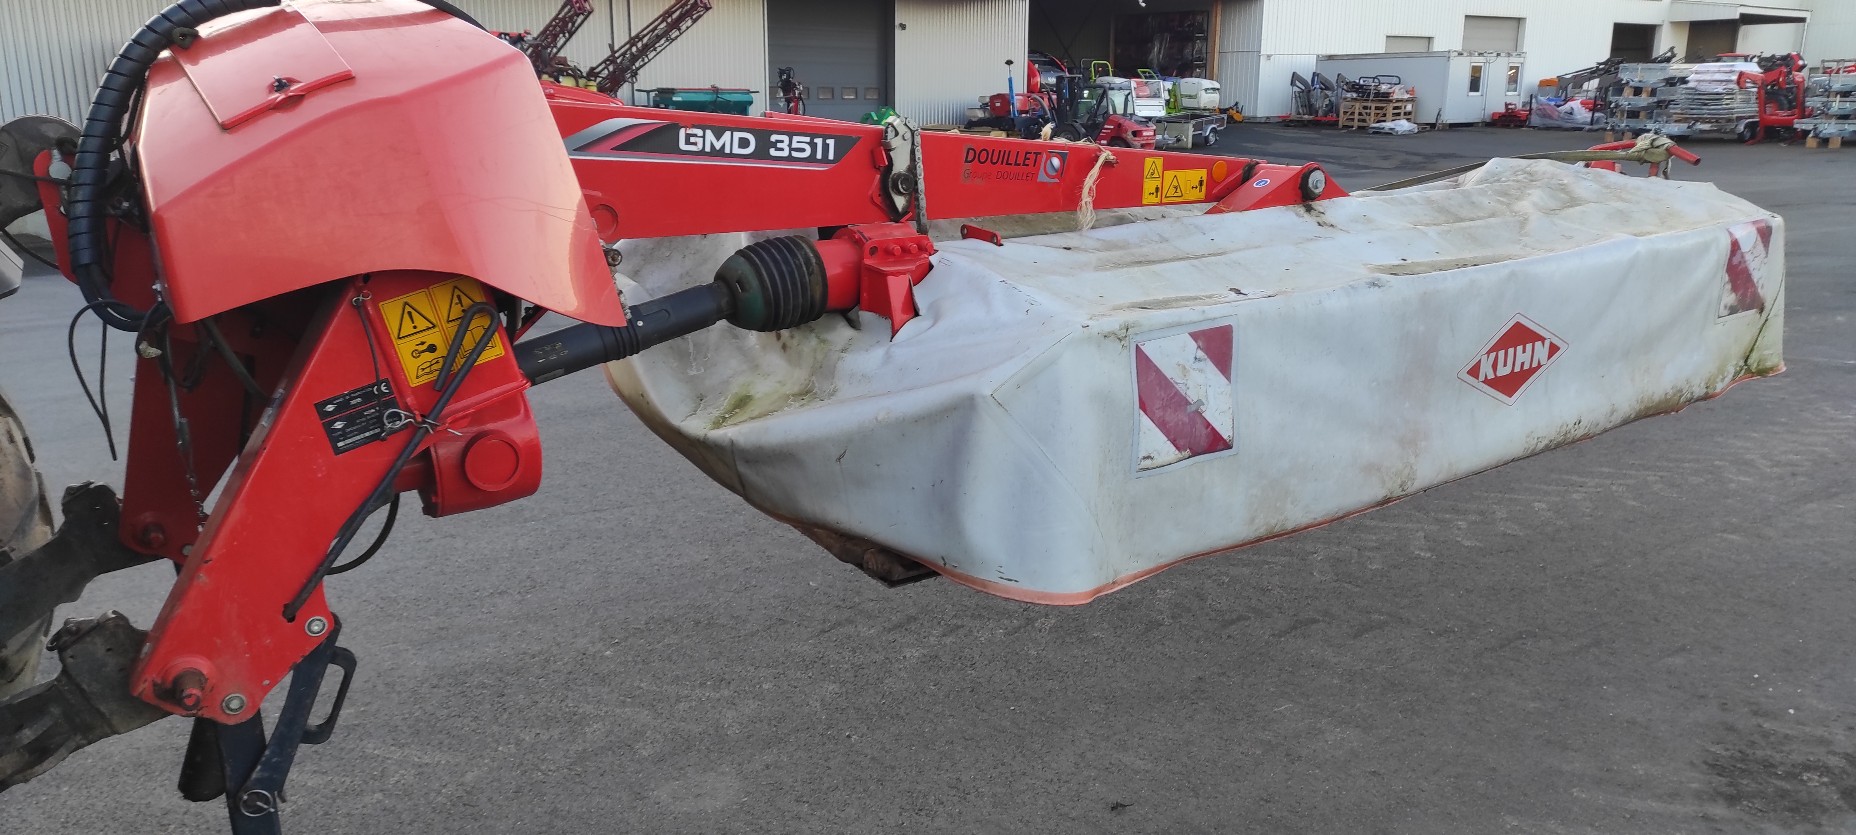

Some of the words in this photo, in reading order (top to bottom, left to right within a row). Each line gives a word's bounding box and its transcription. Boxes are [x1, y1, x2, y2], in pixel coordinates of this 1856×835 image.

[678, 127, 756, 155] GMD
[769, 134, 835, 161] 3511
[964, 147, 1041, 167] DOUILLET
[996, 170, 1035, 182] DOUILLET
[1479, 338, 1551, 382] KUHN
